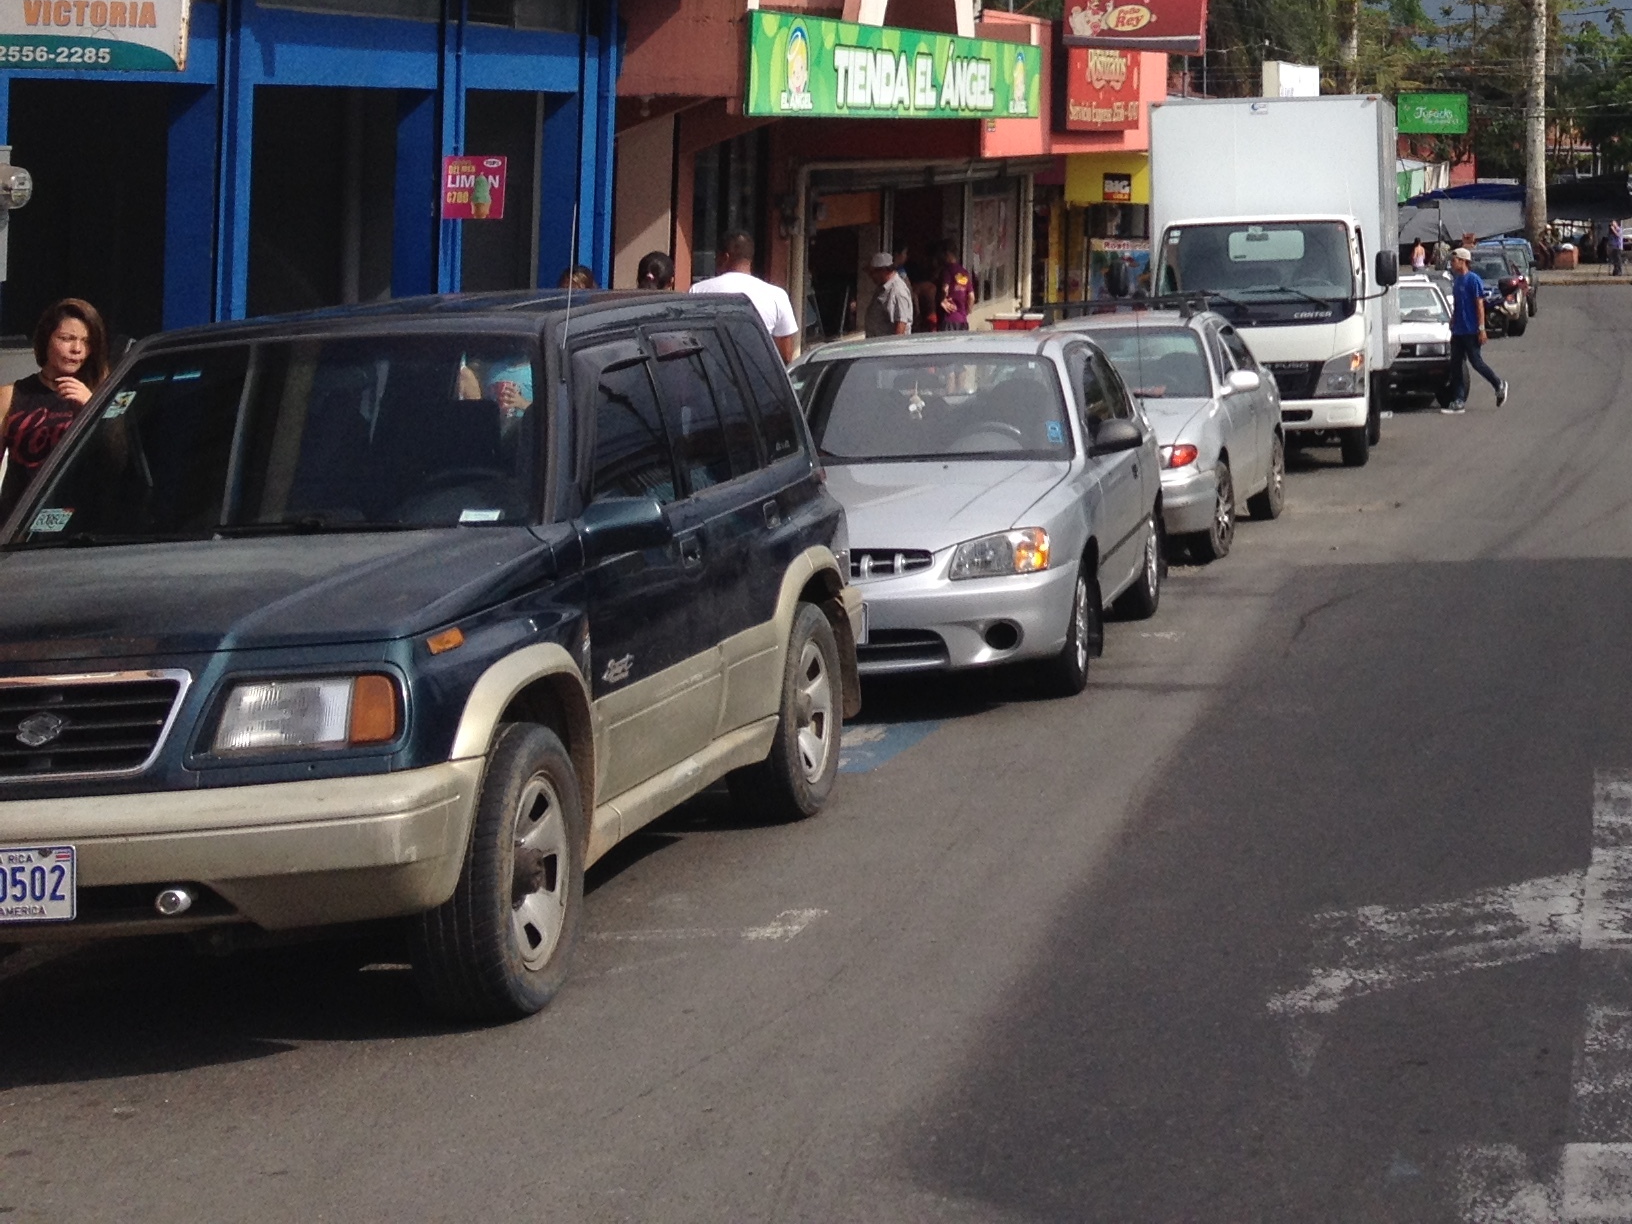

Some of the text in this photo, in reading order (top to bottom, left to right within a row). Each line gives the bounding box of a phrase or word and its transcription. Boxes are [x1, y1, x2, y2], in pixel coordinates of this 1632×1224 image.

[23, 0, 157, 28] VICTORIA
[1114, 14, 1144, 29] Rey
[834, 40, 995, 112] TIENDA EL ÁNGEL
[447, 172, 500, 188] LIMN
[1294, 311, 1333, 319] CANTER
[8, 854, 33, 864] RICA
